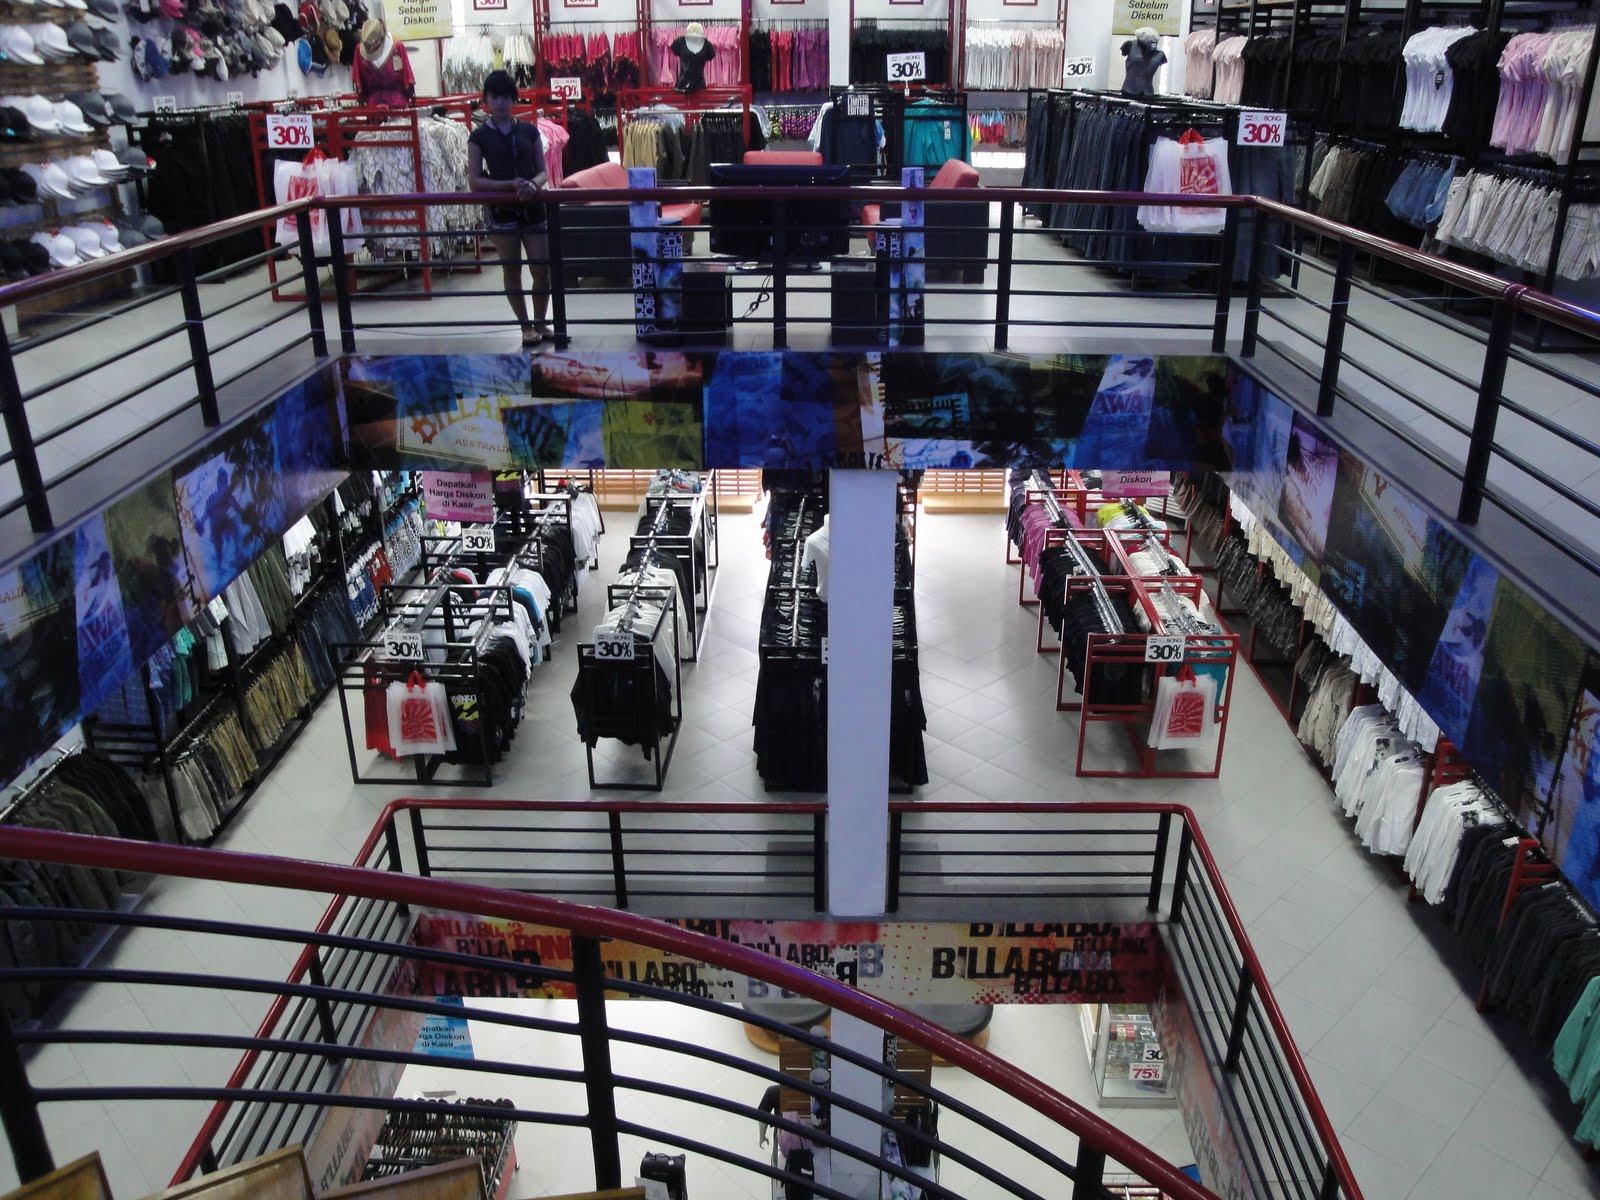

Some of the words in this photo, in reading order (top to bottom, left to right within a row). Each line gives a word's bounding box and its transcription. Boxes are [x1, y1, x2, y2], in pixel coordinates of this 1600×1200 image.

[398, 5, 437, 15] Sebelum
[1128, 0, 1168, 10] Sebelum
[403, 16, 435, 25] Diskon
[1131, 11, 1164, 20] Diskon
[892, 61, 922, 78] 30%
[1067, 63, 1093, 76] 30%
[272, 125, 310, 145] 30%
[1243, 123, 1281, 143] 30%
[436, 478, 477, 489] Dapatkan
[1120, 475, 1152, 484] Diskon
[429, 488, 454, 499] Harga
[456, 490, 486, 499] Diskon
[465, 535, 493, 549] 30%
[388, 641, 421, 657] 30%
[598, 641, 632, 657] 30%
[1148, 644, 1181, 660] 30%
[422, 1026, 455, 1034] apatkan
[419, 1034, 432, 1042] rga
[1132, 1068, 1160, 1079] 75%
